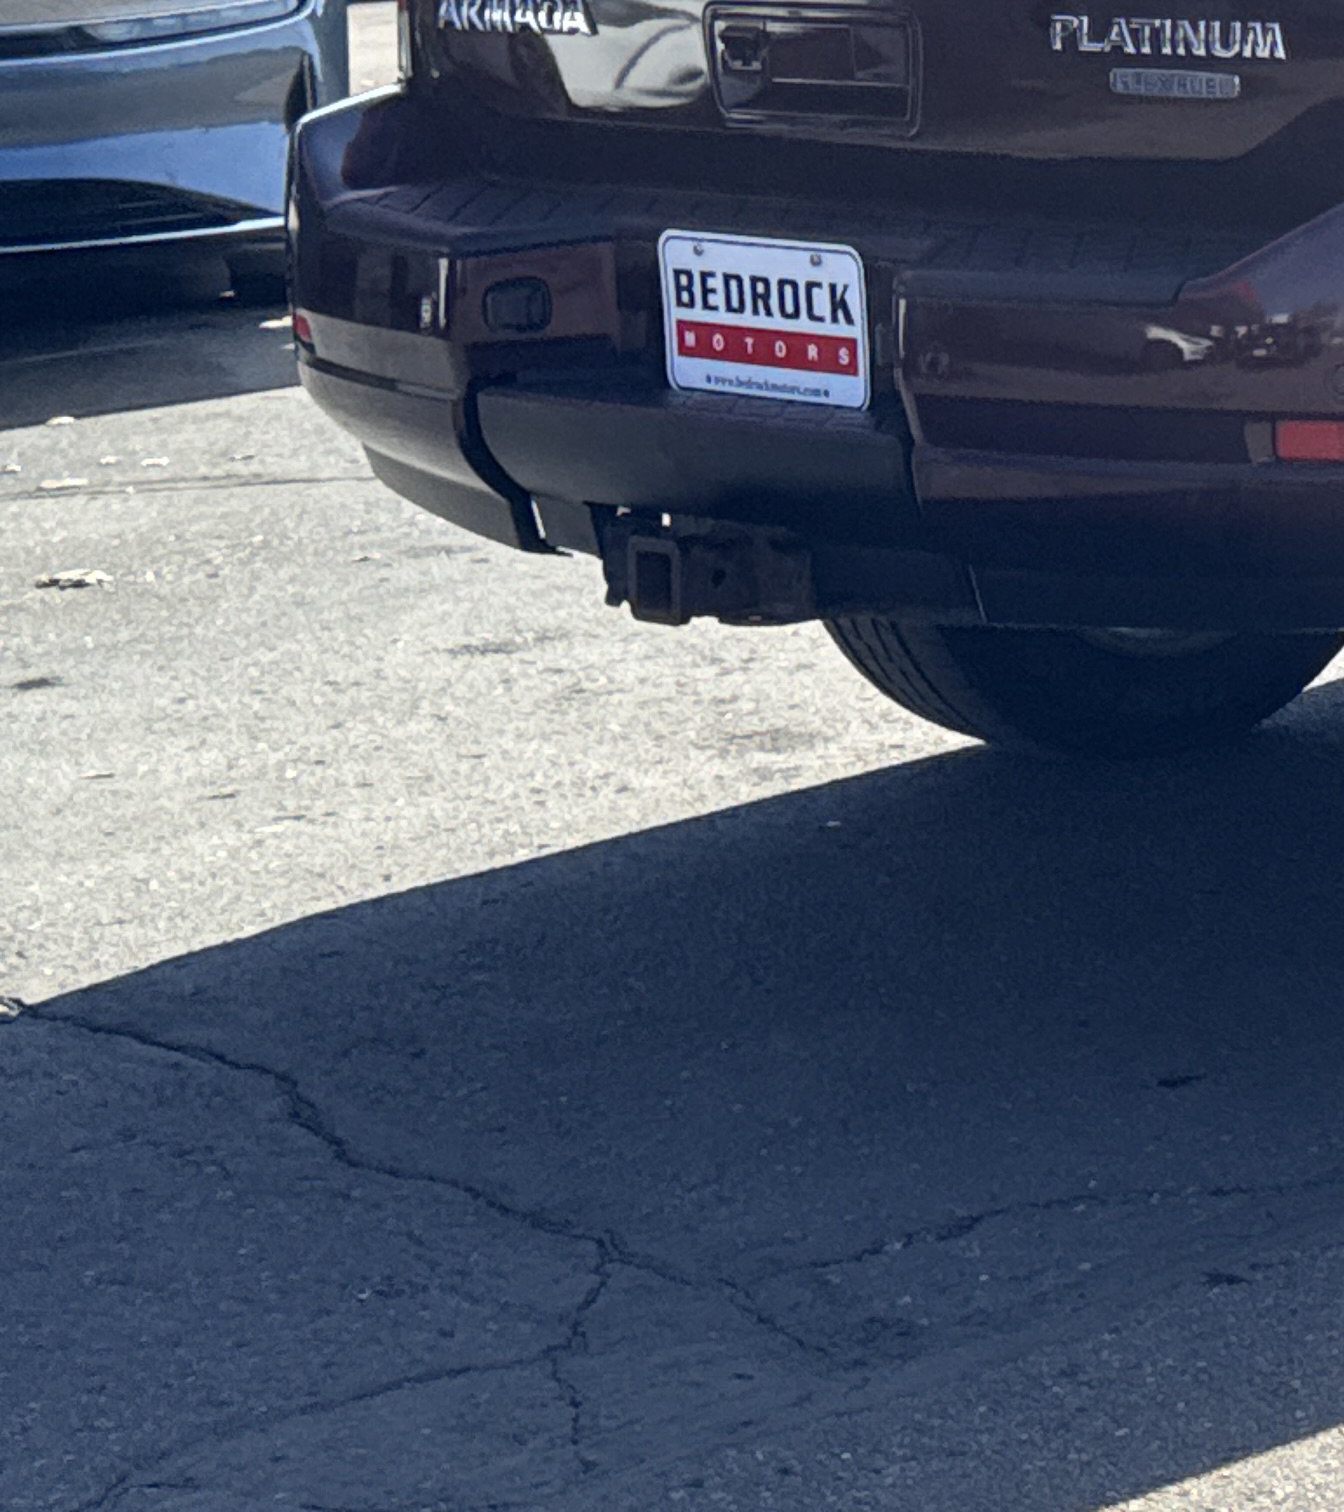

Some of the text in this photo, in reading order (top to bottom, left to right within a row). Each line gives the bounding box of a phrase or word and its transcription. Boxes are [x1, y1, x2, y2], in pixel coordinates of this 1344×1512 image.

[1049, 14, 1287, 60] PLATINUM
[673, 268, 855, 326] BEDROCK
[683, 330, 850, 366] MOTORS
